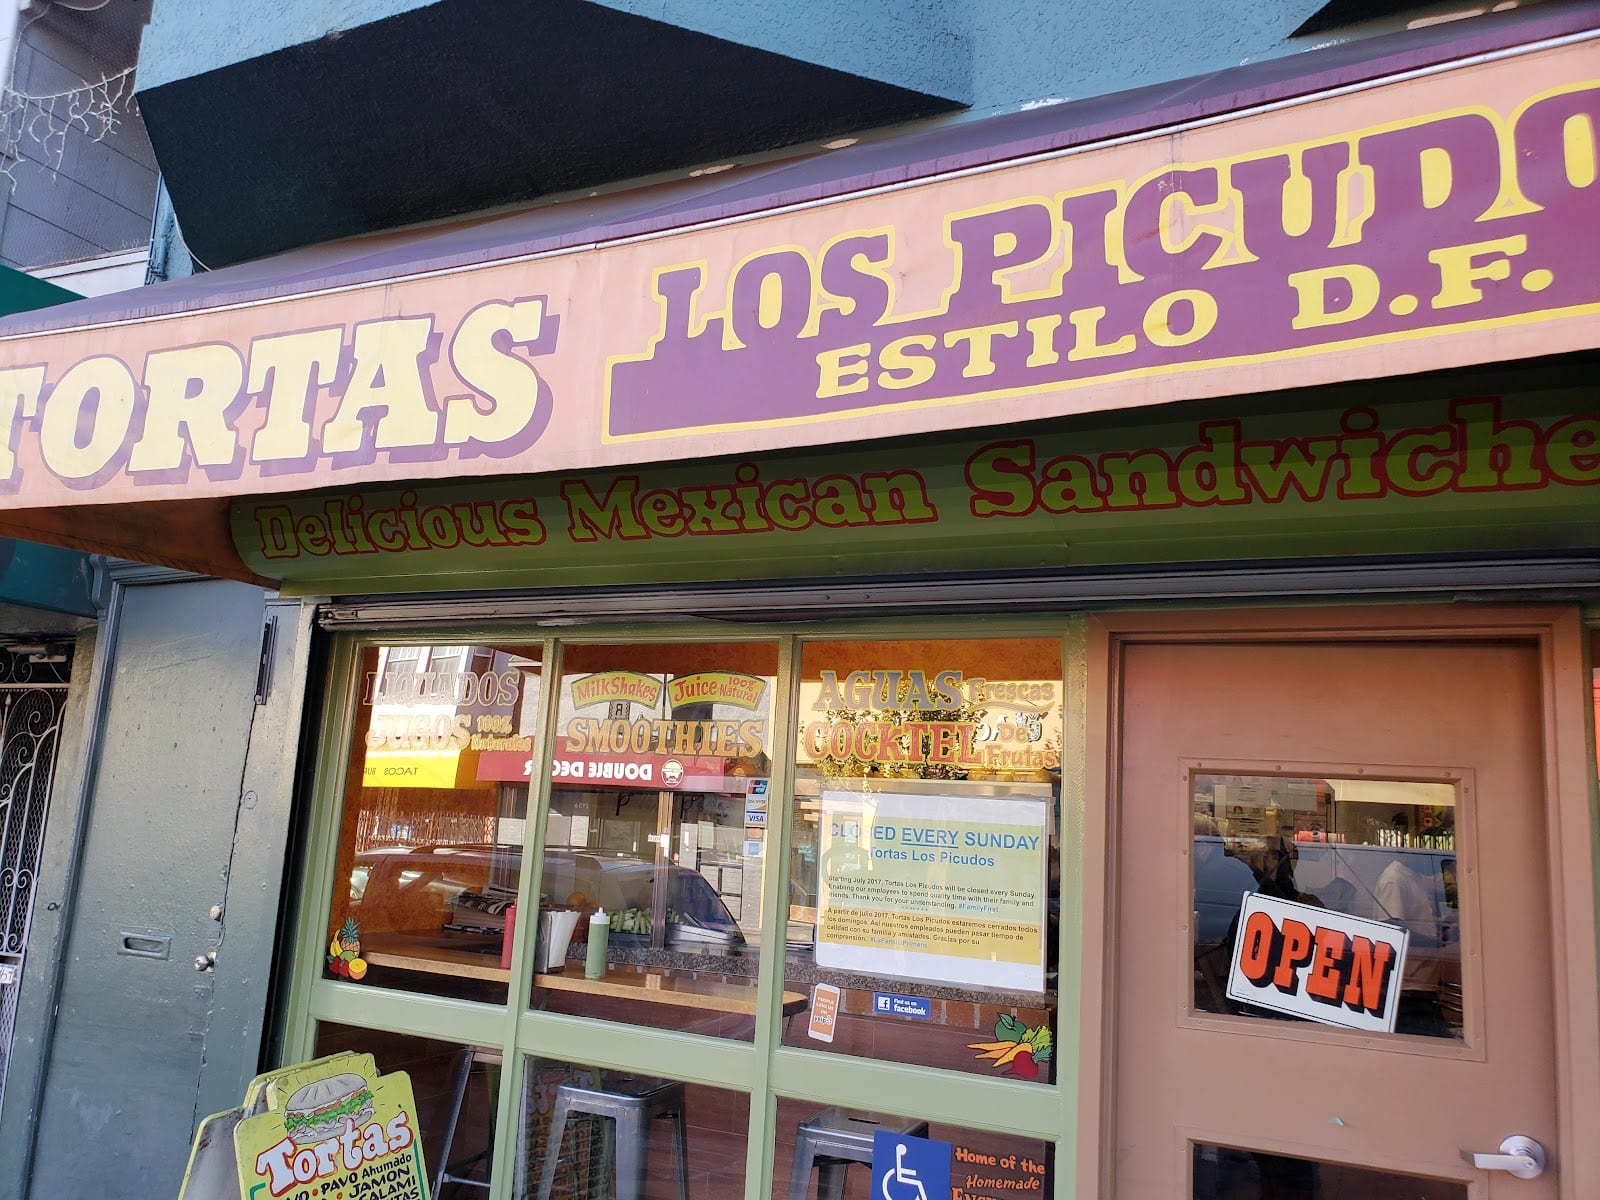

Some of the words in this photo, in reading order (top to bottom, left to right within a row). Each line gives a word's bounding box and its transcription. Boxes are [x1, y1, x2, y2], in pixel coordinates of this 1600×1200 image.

[651, 225, 897, 350] LOS
[944, 81, 1600, 305] PICUDO
[815, 288, 1218, 400] ESTILO
[1288, 233, 1554, 330] D.F.
[255, 488, 547, 560] Delicious
[561, 462, 937, 543] Mexican
[966, 398, 1600, 518] Sandwiche
[673, 676, 717, 702] Juice
[720, 684, 760, 703] Natural
[728, 677, 757, 691] 100%
[812, 670, 963, 711] AGUAS
[968, 678, 1055, 702] Frescas
[476, 714, 513, 734] 100%
[1000, 723, 1027, 743] De
[566, 717, 763, 758] SMOOTHIES
[804, 721, 984, 763] COCKTEL
[985, 743, 1056, 768] Frutas
[748, 814, 764, 822] VISA
[831, 823, 896, 841] CLOED
[901, 827, 958, 845] EVERY
[965, 831, 1039, 850] SUNDAY
[912, 850, 935, 862] Los
[940, 851, 994, 866] Picudos
[909, 890, 928, 898] spend
[1010, 890, 1035, 899] Sunday
[952, 920, 986, 929] estaremos
[987, 923, 1017, 931] cerrados
[1239, 911, 1396, 1019] OPEN
[893, 1004, 926, 1016] facebook
[255, 1110, 413, 1198] Tortas
[955, 1147, 997, 1166] Home
[999, 1155, 1017, 1169] of
[1020, 1158, 1045, 1174] the
[321, 1171, 358, 1195] PAVO
[361, 1153, 412, 1180] Ahumado
[348, 1165, 410, 1198] JAMON
[965, 1173, 1040, 1190] Homemade
